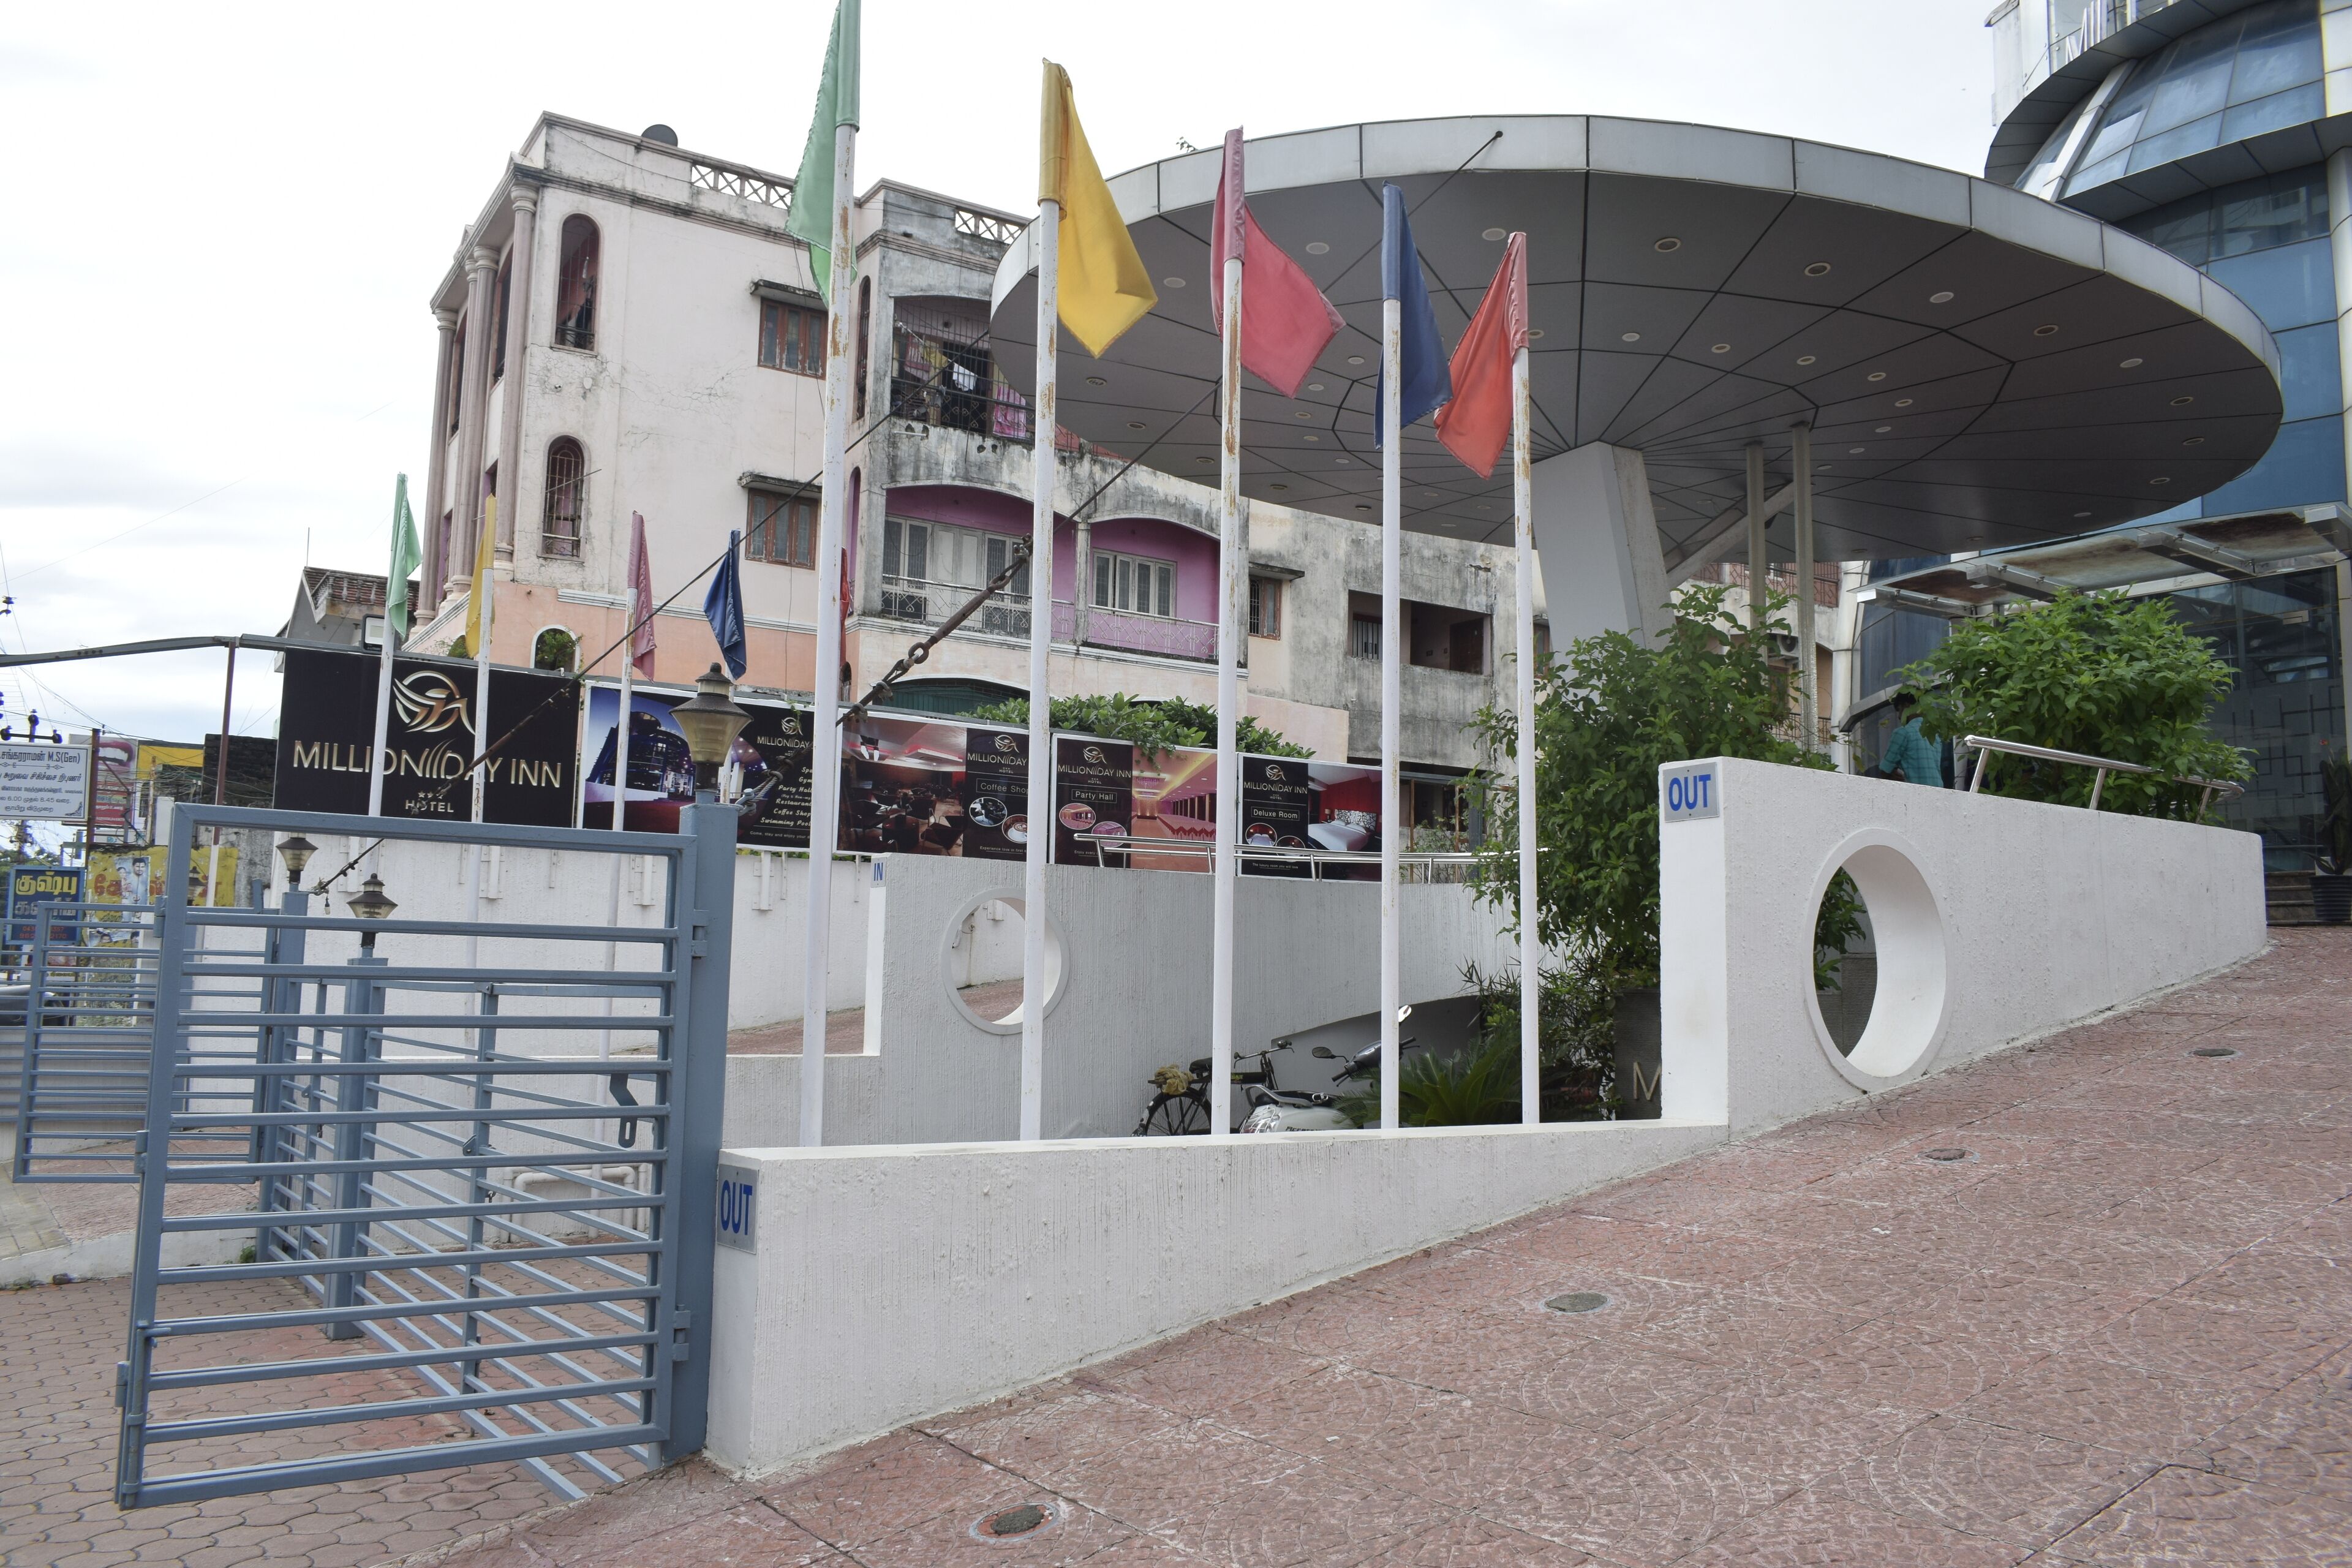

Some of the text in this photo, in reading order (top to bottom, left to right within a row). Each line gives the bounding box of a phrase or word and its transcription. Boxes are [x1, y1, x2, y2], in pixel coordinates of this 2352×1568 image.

[510, 758, 562, 788] INN
[1116, 769, 1133, 778] INN
[778, 785, 797, 793] Party
[980, 782, 1008, 792] Coffee
[1294, 786, 1308, 794] INN
[1075, 791, 1096, 801] Party
[1668, 774, 1711, 812] OUT
[405, 799, 454, 813] HOTEL
[1253, 809, 1298, 820] Deluxe Room
[760, 817, 794, 827] Swimming
[873, 862, 884, 881] IN
[720, 1179, 753, 1235] OUT
